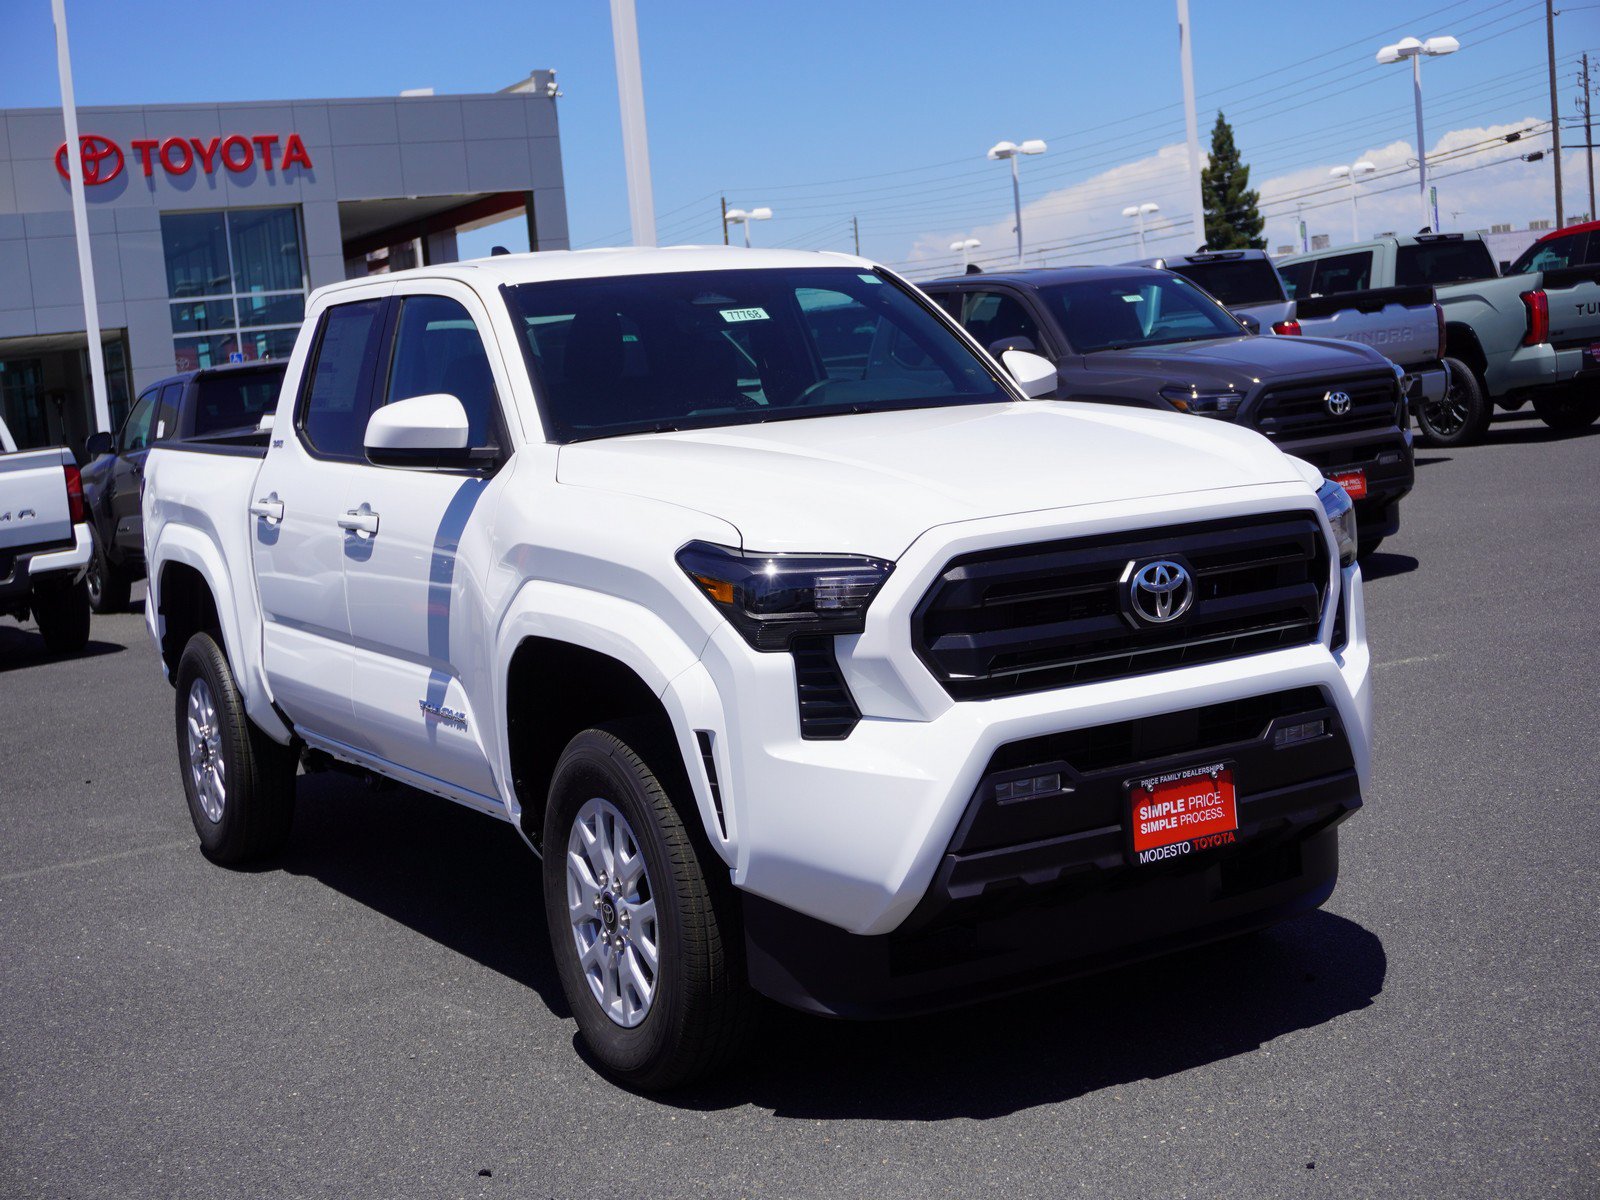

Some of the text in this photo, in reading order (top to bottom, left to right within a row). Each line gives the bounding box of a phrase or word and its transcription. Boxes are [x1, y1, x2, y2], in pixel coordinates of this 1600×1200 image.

[131, 134, 312, 177] TOYOTA
[727, 310, 762, 321] 77768
[1575, 302, 1600, 316] TU
[1141, 763, 1225, 788] PRICE FAMILY DEALERSHIPS
[1139, 791, 1224, 821] SIMPLE PRICE.
[1140, 806, 1226, 835] SIMPLE PROCESS.
[1139, 832, 1236, 864] MODESTO TOYOTA
